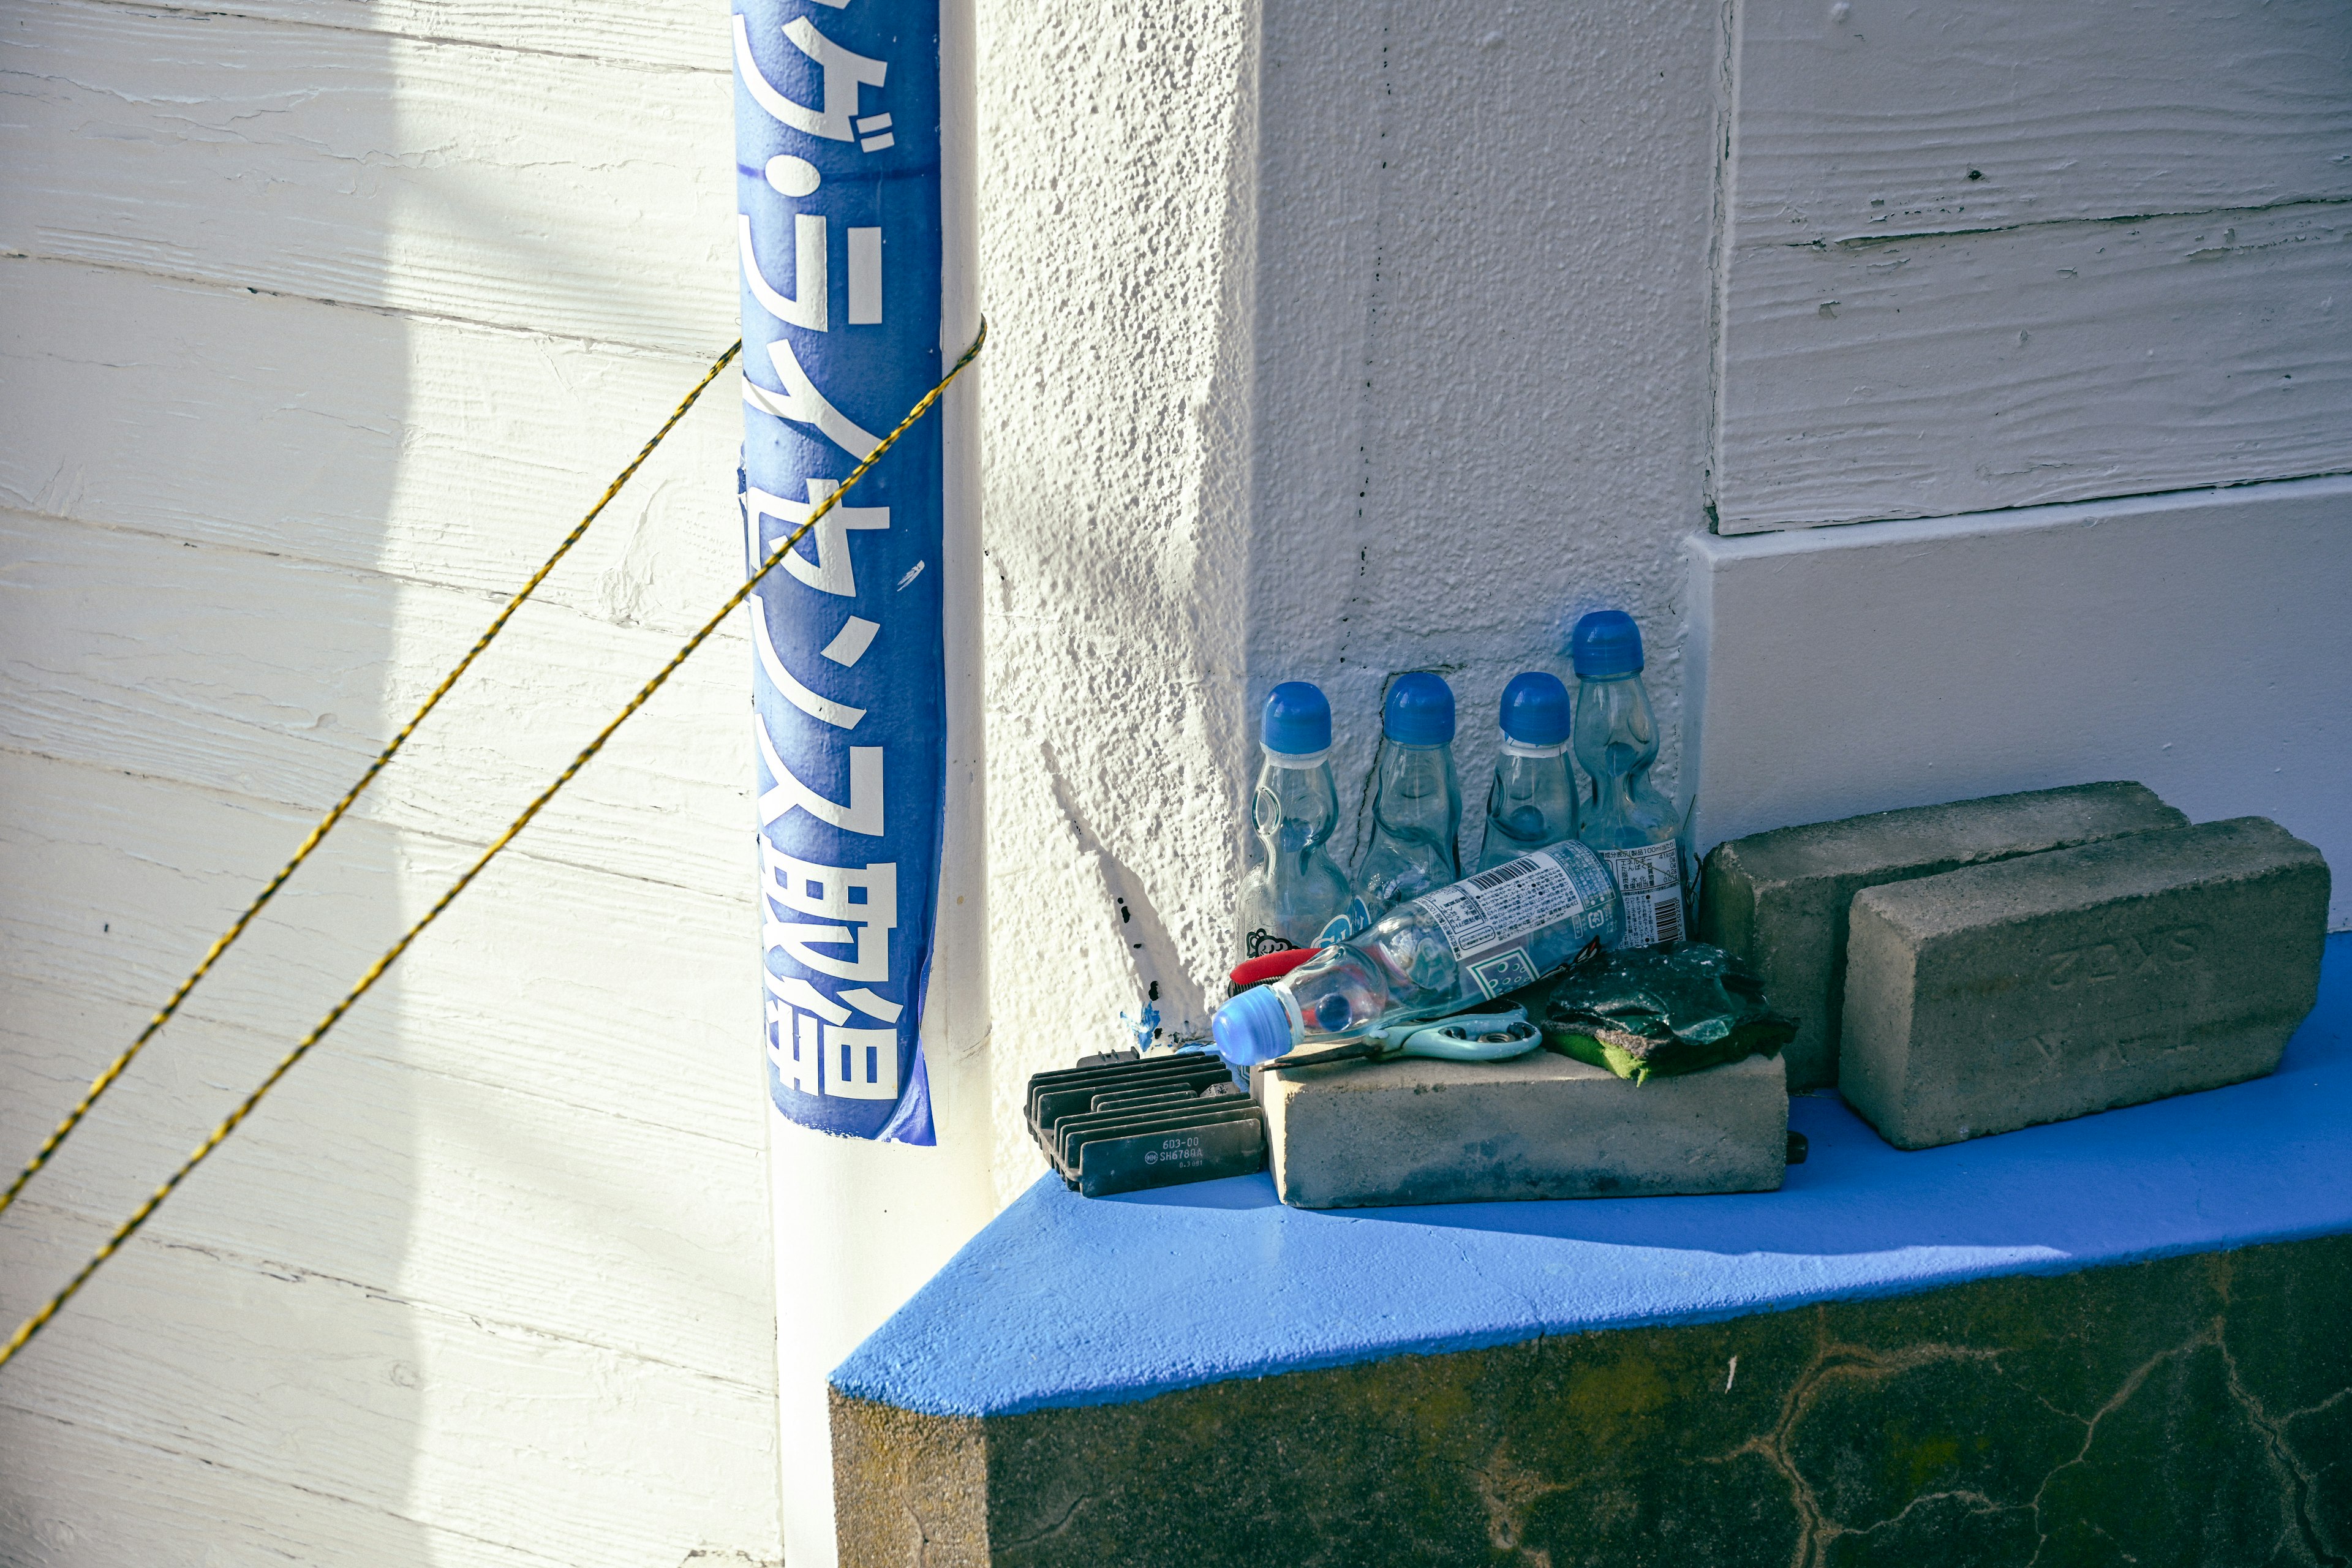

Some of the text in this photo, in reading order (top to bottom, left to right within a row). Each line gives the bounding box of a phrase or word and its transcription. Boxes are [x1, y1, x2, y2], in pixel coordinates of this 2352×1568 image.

[732, 0, 904, 1100] グ・ライセンス取得
[1621, 857, 1651, 865] エネルギー
